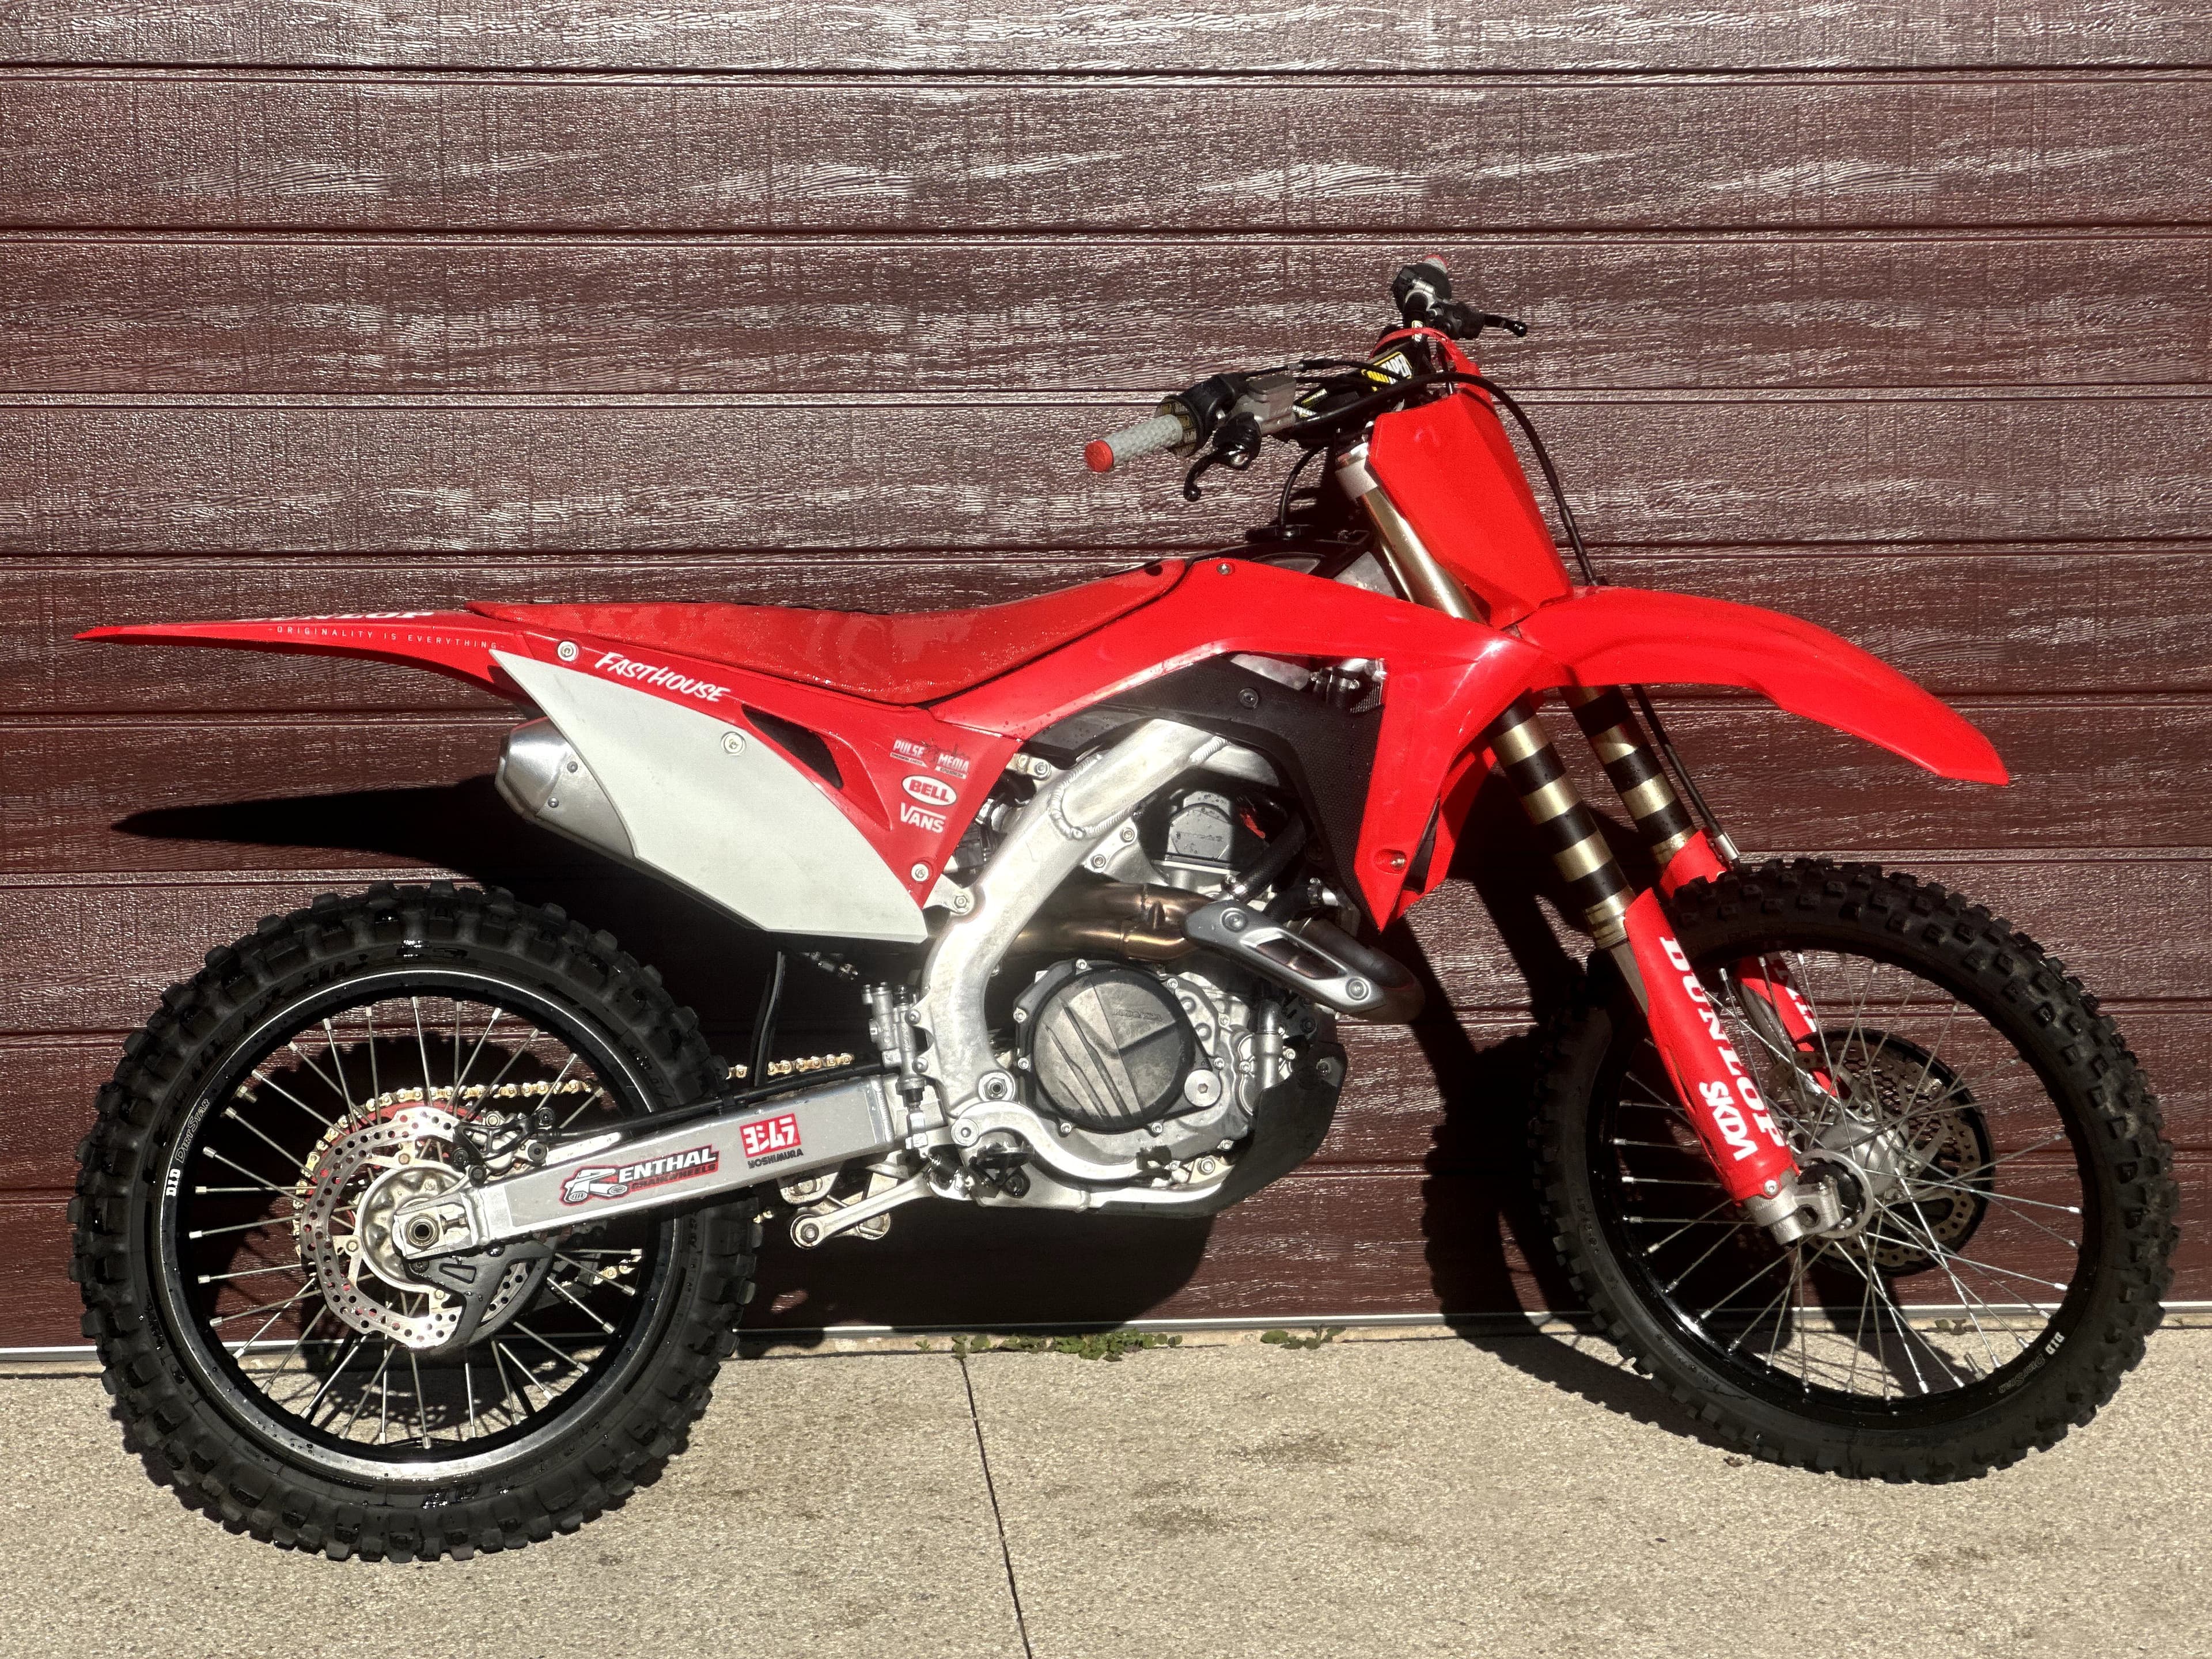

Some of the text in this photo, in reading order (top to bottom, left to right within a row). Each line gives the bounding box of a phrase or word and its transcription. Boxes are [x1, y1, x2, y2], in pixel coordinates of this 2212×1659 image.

[594, 652, 731, 702] FASTHOUSE
[893, 739, 925, 758] PULSE
[937, 753, 970, 773] MEDIA
[908, 779, 949, 802] BELL
[900, 802, 946, 833] VANS
[1660, 937, 1785, 1147] DUNLOP
[743, 1116, 795, 1154] ヨシムラ
[747, 1148, 804, 1169] YOSHIMURA
